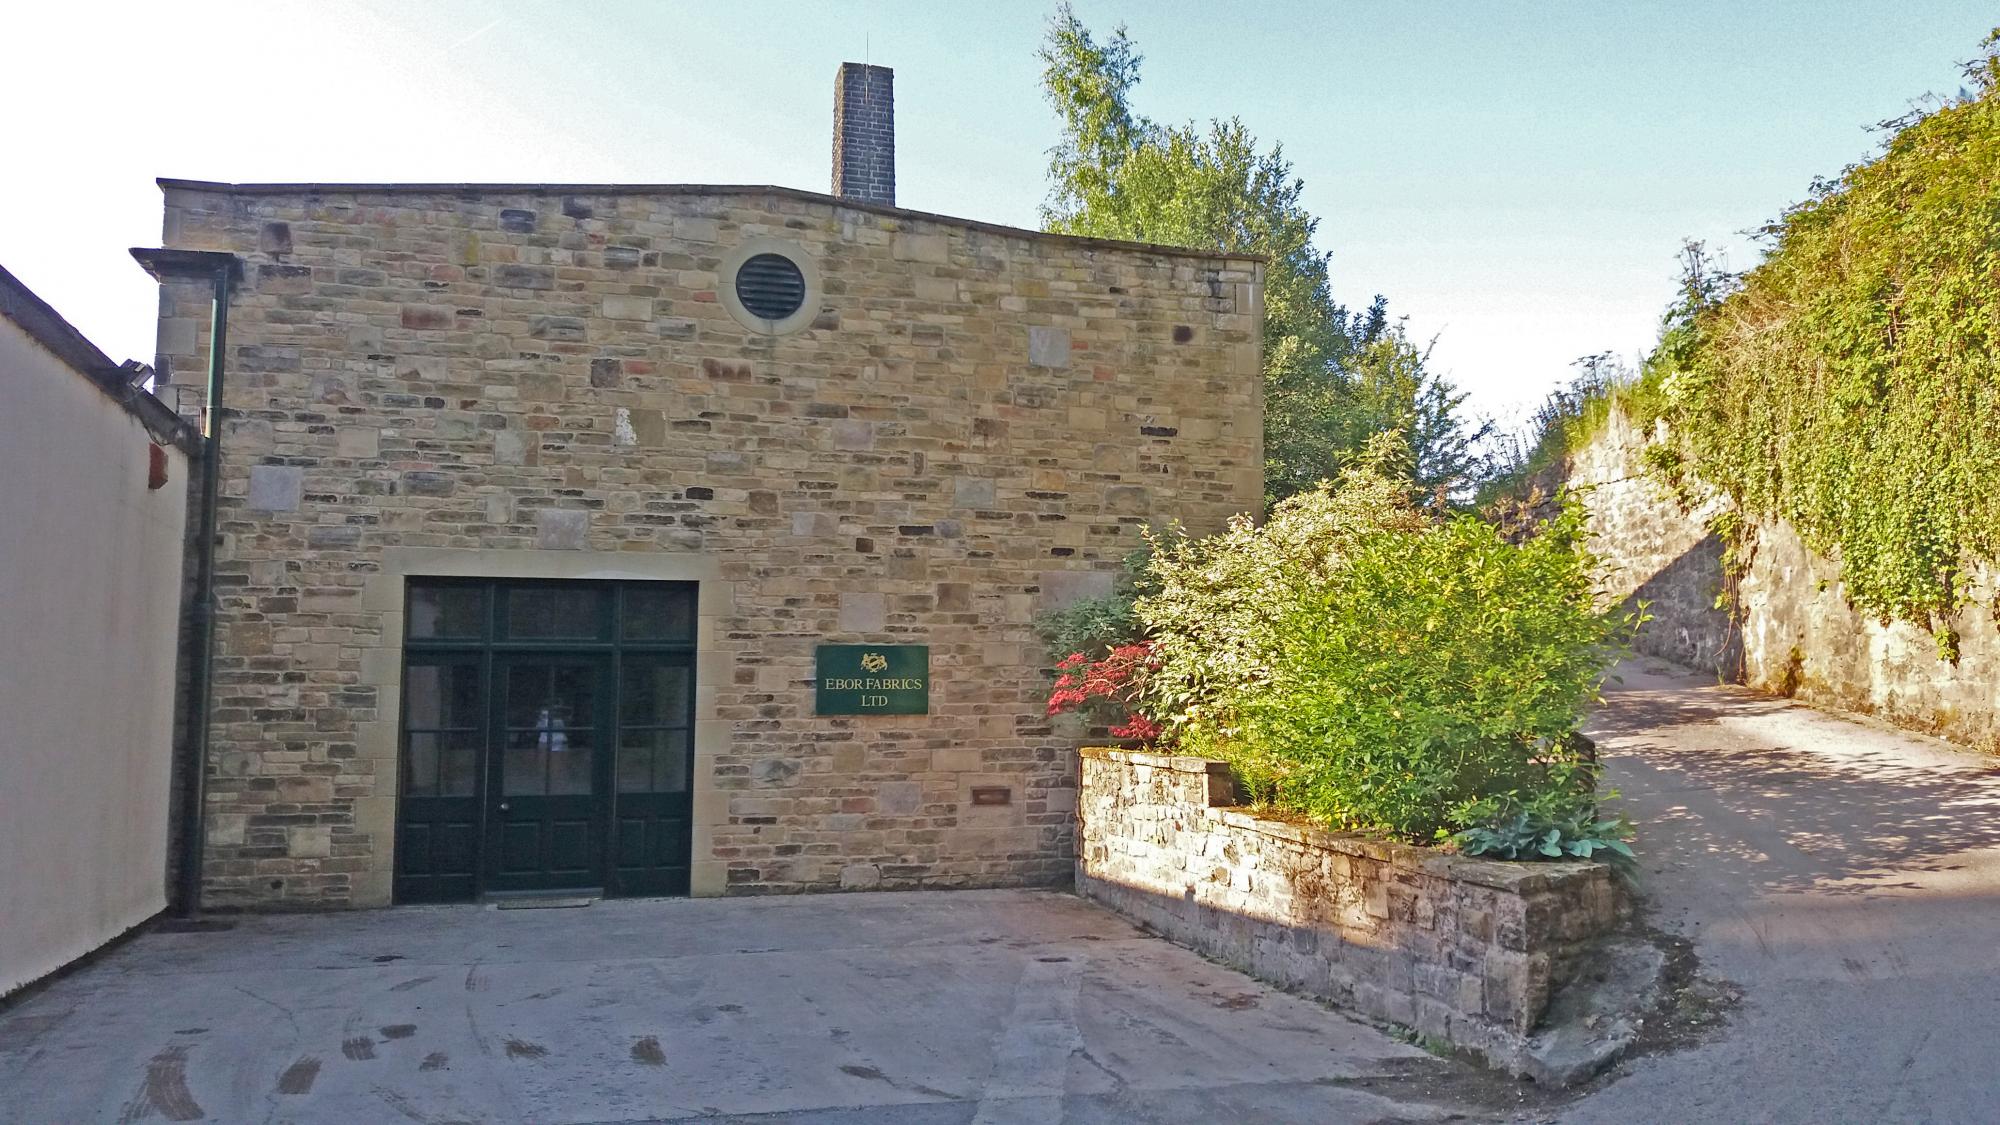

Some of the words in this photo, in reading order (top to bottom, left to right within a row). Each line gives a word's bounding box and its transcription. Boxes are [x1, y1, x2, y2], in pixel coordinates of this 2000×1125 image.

[825, 678, 863, 690] EBOR
[866, 678, 922, 690] FABRICS
[861, 695, 888, 707] LTD
